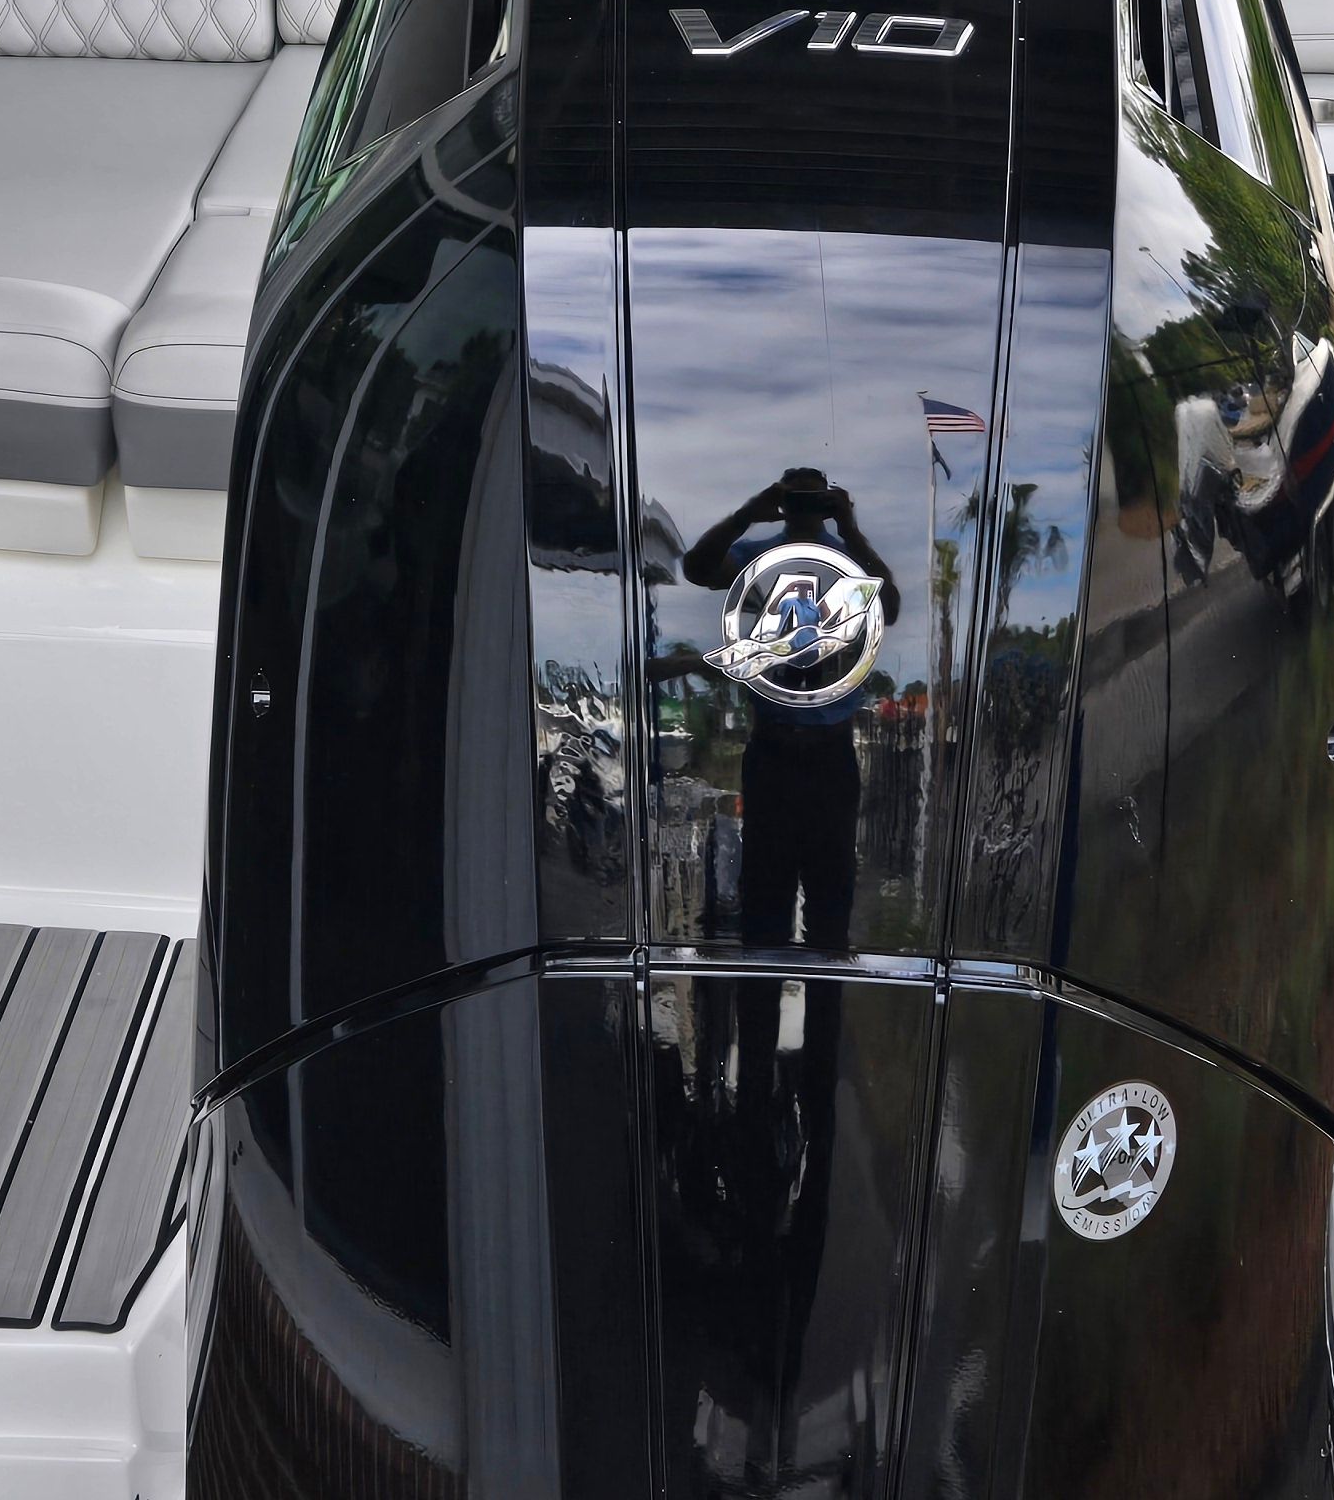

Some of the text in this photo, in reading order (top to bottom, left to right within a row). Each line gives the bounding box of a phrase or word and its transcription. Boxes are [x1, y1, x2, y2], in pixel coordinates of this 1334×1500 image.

[668, 8, 975, 56] V10
[1076, 1088, 1169, 1133] ULTRA LOW
[1072, 1195, 1154, 1236] EMISSION
